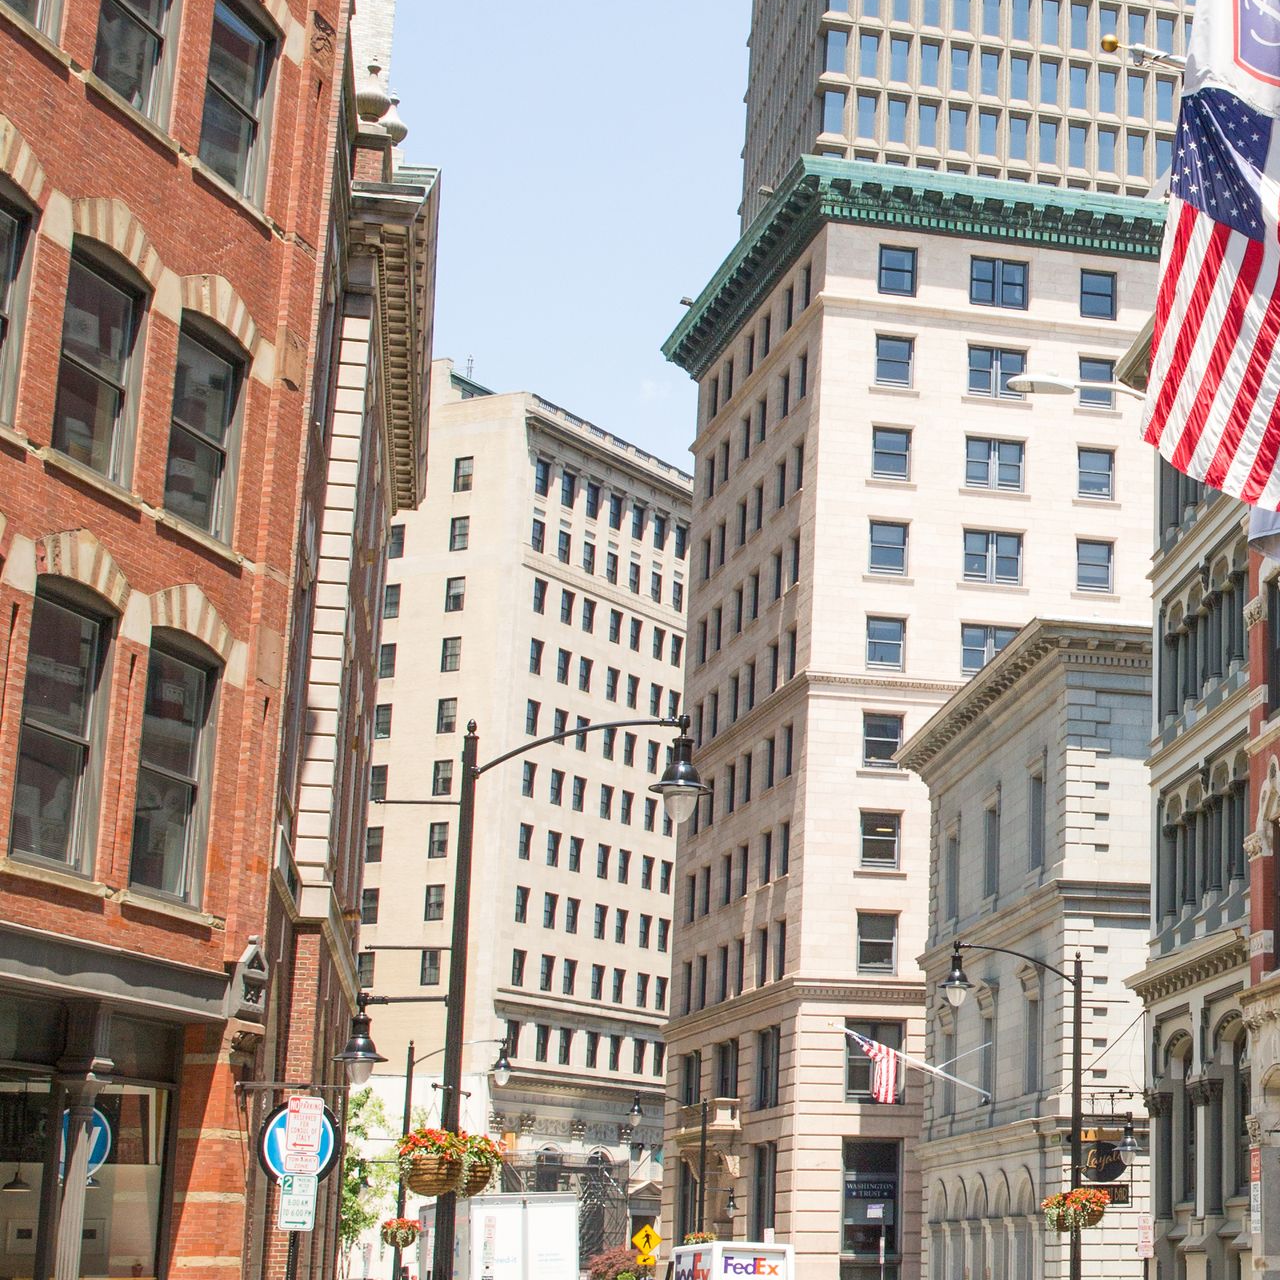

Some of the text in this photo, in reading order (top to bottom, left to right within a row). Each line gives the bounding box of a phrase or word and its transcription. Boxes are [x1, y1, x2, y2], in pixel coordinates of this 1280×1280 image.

[291, 1100, 321, 1111] NO PARKING
[296, 1134, 312, 1142] ITALY
[283, 1175, 293, 1190] 2
[1114, 1186, 1128, 1201] BAR
[723, 1256, 779, 1276] FedEx
